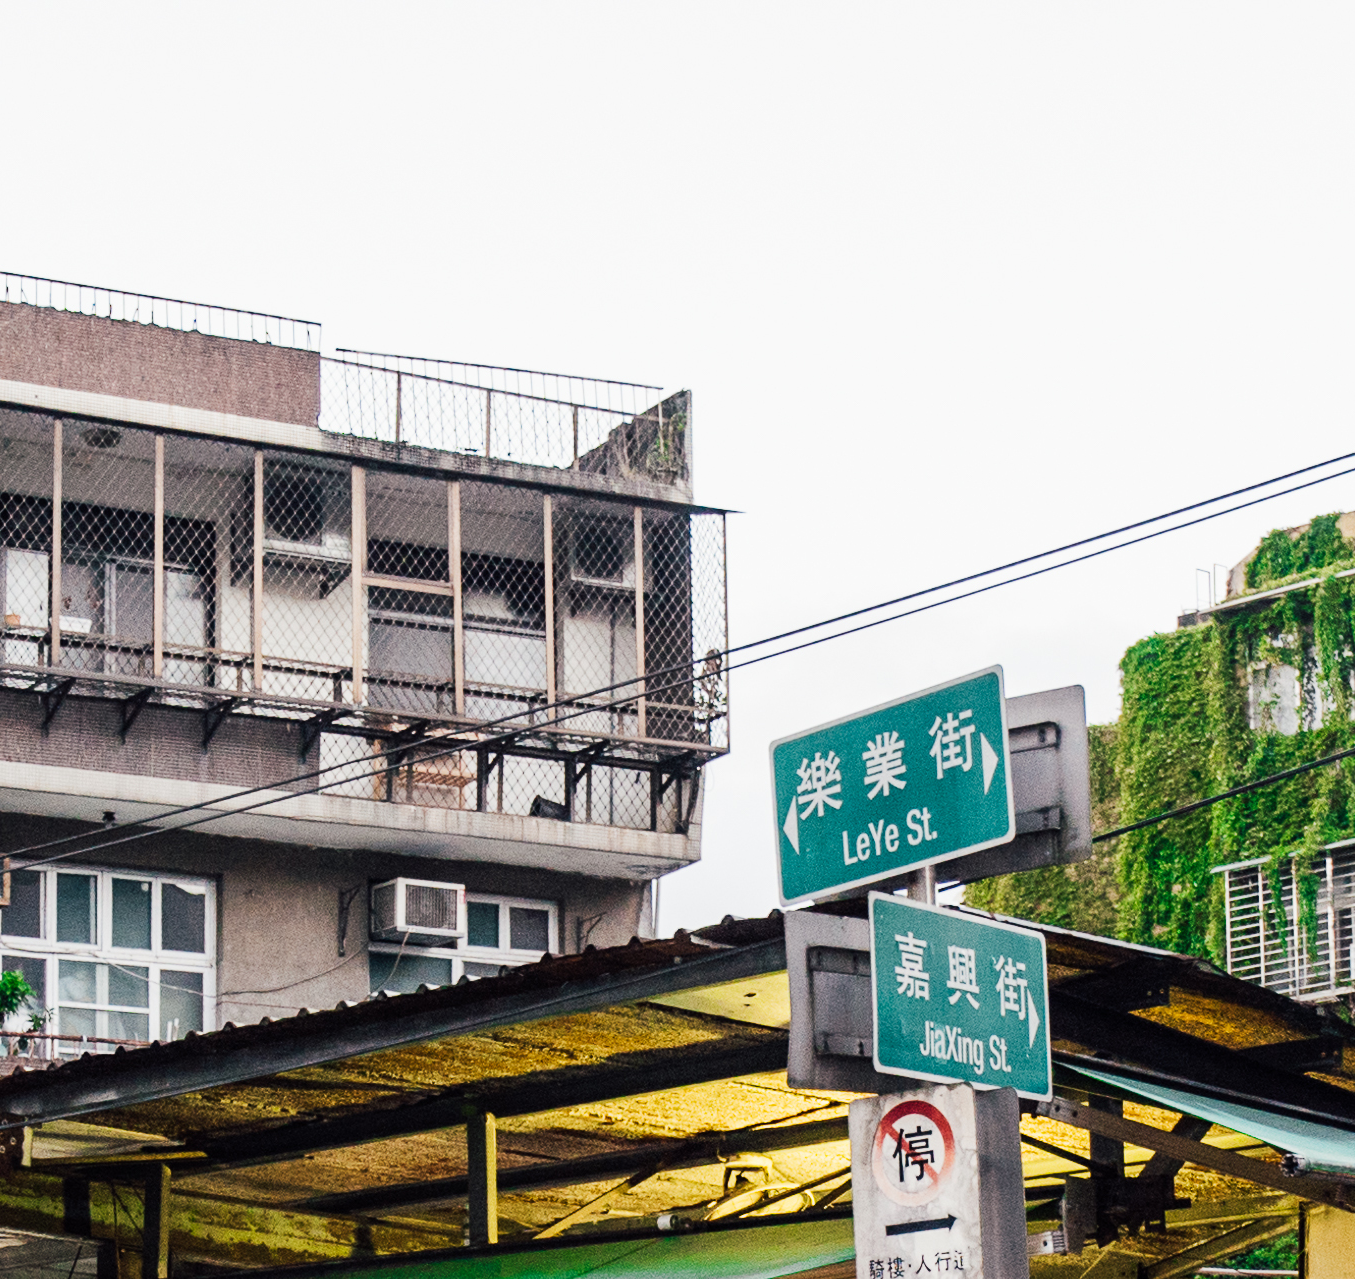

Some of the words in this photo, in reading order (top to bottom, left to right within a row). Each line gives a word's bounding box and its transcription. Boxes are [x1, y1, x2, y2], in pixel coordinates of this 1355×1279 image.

[796, 709, 976, 821] 樂業街
[842, 818, 900, 866] LeYe
[906, 807, 938, 847] St.
[894, 931, 1029, 1021] 嘉興街
[919, 1021, 985, 1075] JiaXing
[989, 1034, 1012, 1073] St.
[892, 1125, 935, 1183] 停
